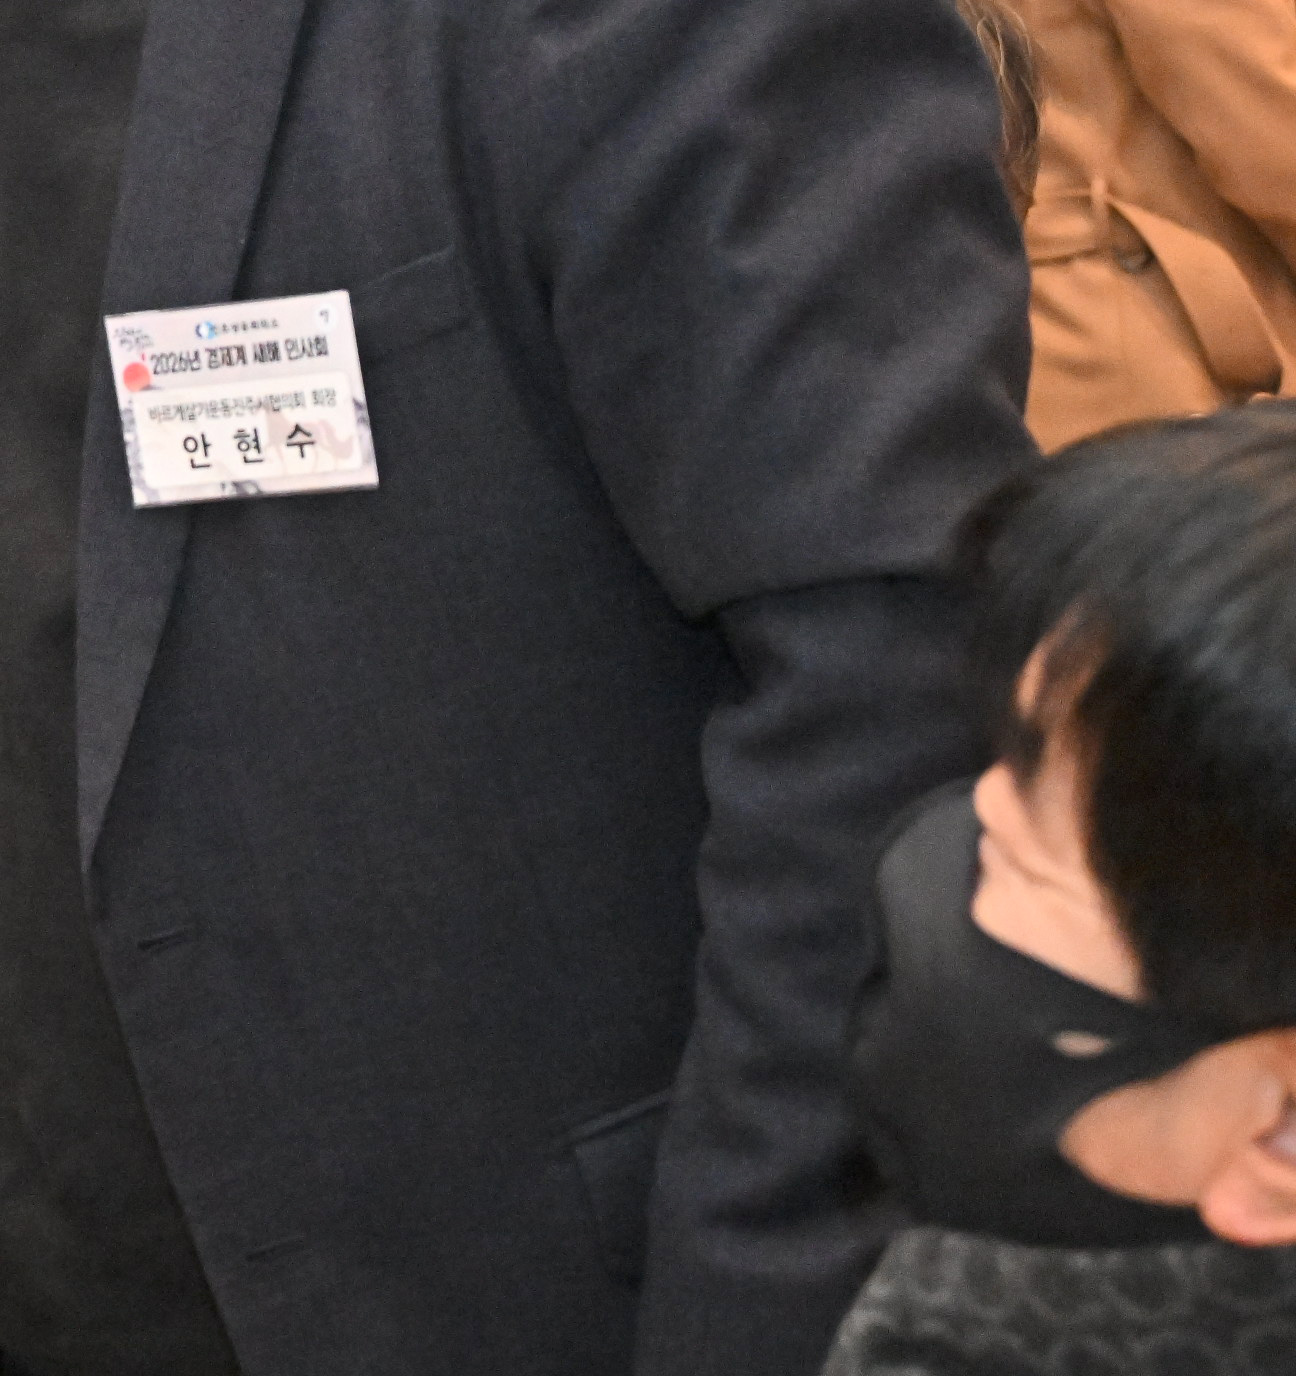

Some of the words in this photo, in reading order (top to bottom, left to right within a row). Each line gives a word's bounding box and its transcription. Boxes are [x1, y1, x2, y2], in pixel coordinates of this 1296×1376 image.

[150, 349, 202, 375] 2026년
[205, 344, 248, 369] 경제계
[253, 340, 280, 363] 새해
[284, 335, 329, 360] 인사회
